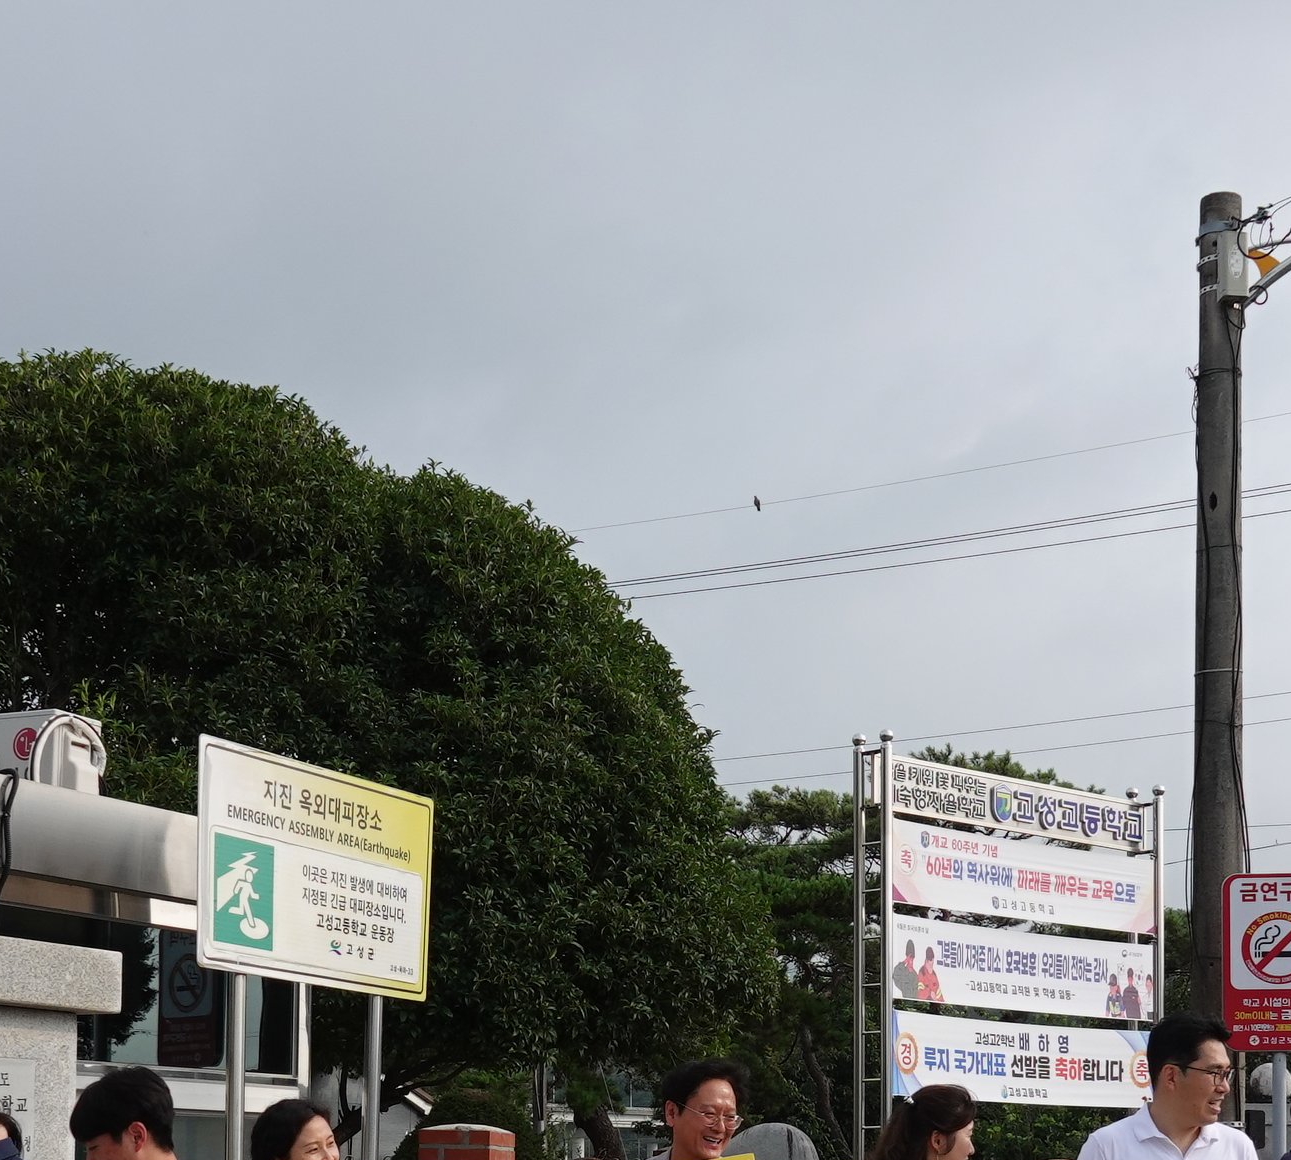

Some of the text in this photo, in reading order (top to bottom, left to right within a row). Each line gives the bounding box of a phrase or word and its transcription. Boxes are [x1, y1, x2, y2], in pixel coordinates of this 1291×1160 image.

[936, 771, 949, 790] 꽃
[951, 774, 986, 797] 피우는
[263, 780, 382, 832] 지진 옥외대피장소
[1016, 790, 1142, 840] 고성고등학교
[227, 804, 411, 863] EMERGENCY ASSEMBLY AREA(Earthquake)
[931, 835, 948, 849] 개교
[982, 844, 998, 858] 기념
[900, 850, 912, 868] 축
[302, 865, 408, 903] 이곳은 지진 발생에 대비하여
[1018, 869, 1052, 893] 미래를
[1054, 874, 1088, 898] 깨우는
[302, 887, 406, 924] 지정된 긴급 대피장소입니다.
[1002, 899, 1055, 915] 고성고등학교
[316, 914, 395, 943] 고성고등학교 운동장
[1247, 925, 1257, 936] No
[346, 944, 375, 960] 고성군
[937, 940, 1108, 984] 그분들이 지켜준 미소 호국보훈 우리들이 전하는 감사
[1043, 988, 1056, 1000] 학생
[1243, 998, 1260, 1007] 학교
[1262, 997, 1290, 1007] 시설의
[1234, 1010, 1278, 1020] 30m이내는
[975, 1032, 1015, 1047] 고성고2학년
[901, 1043, 912, 1065] 경
[924, 1047, 1124, 1082] 루지 국가대표 선발을 축하합니다
[1136, 1060, 1149, 1080] 축
[1008, 1087, 1048, 1098] 고성고등학교
